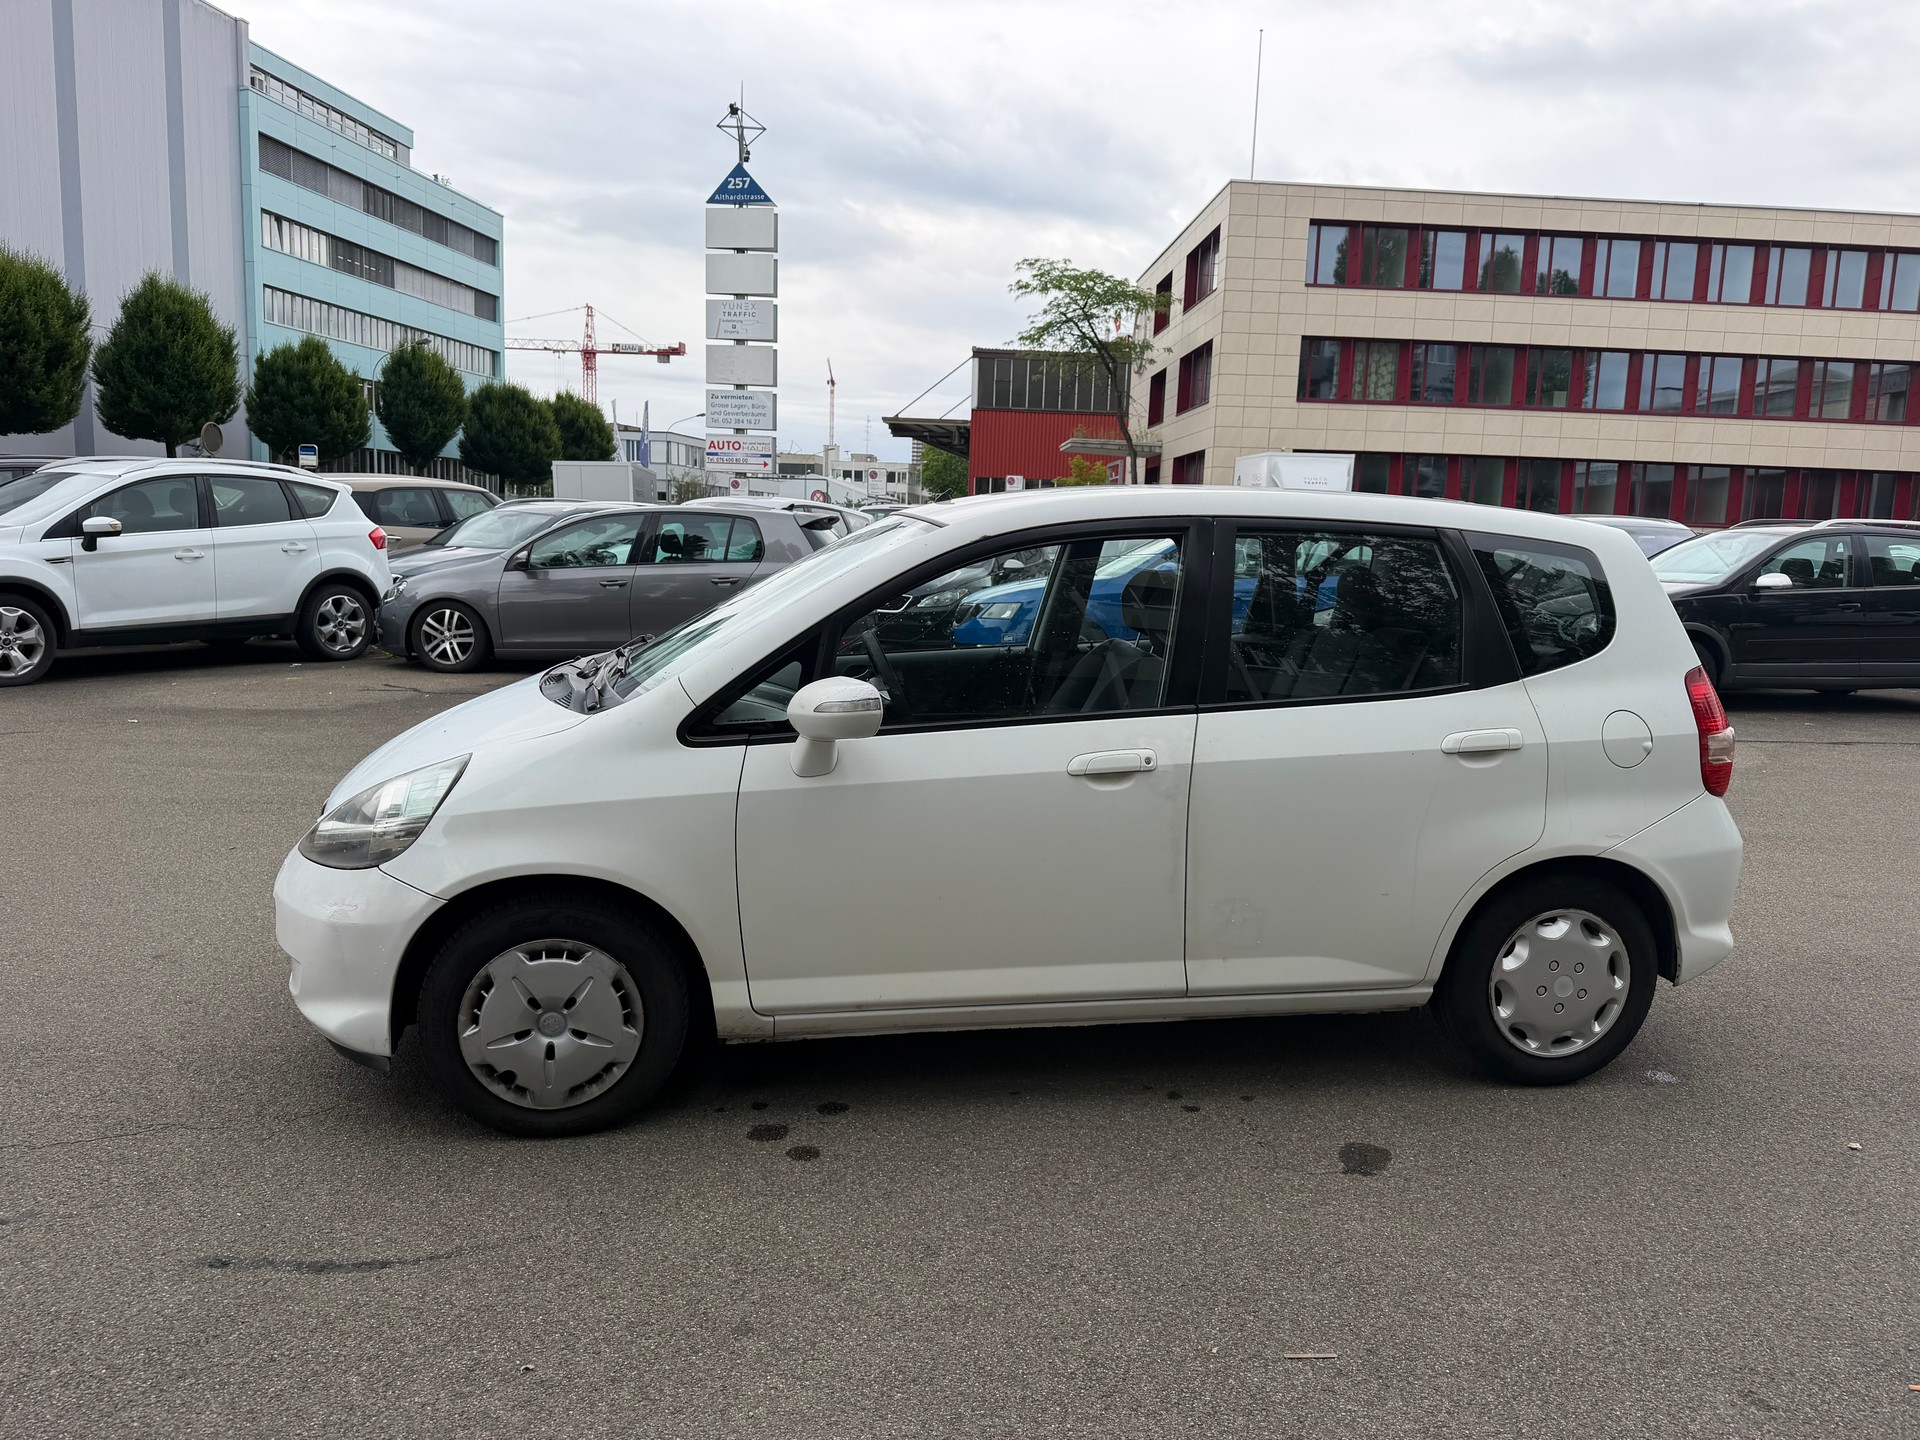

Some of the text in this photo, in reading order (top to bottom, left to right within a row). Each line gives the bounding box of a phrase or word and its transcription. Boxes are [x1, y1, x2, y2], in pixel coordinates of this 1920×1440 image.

[727, 177, 751, 189] 257
[722, 302, 757, 310] YUNEX
[708, 440, 742, 451] AUTO
